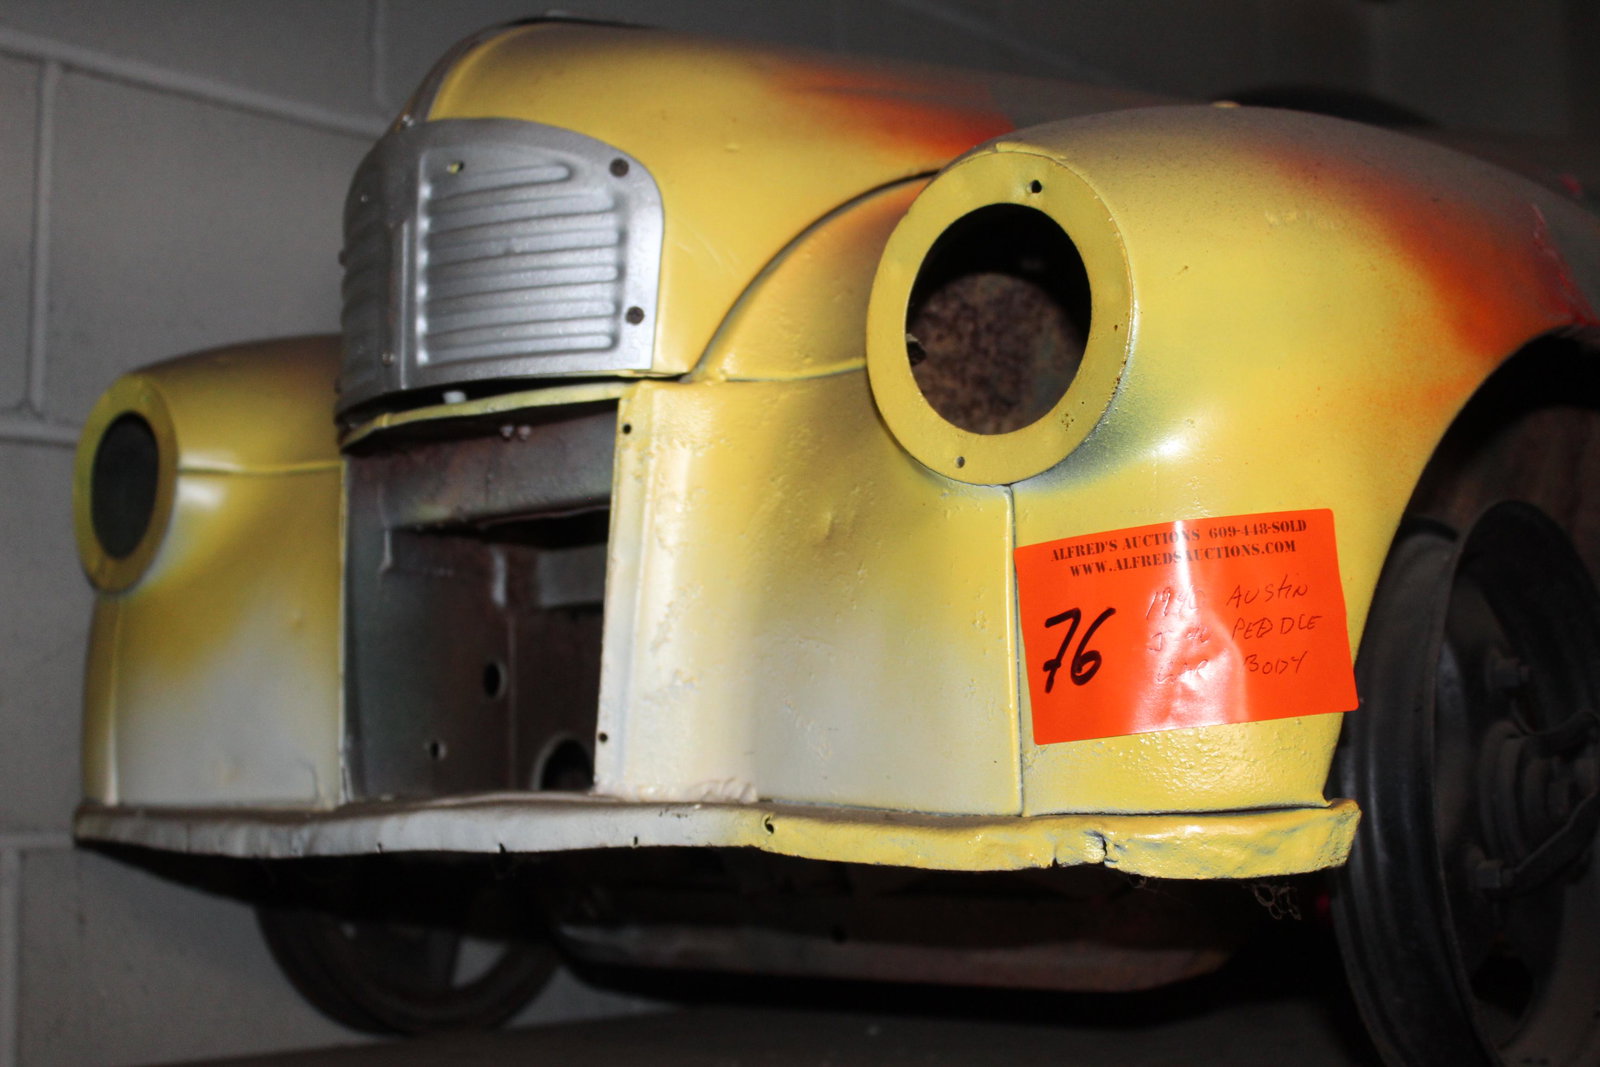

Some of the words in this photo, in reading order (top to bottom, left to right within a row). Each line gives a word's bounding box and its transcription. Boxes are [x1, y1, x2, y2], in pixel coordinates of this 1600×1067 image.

[1050, 539, 1118, 561] ALFRED'S
[1122, 529, 1200, 551] AUCTIONS
[1209, 519, 1307, 539] 609-448-SOLD
[1070, 540, 1296, 577] WWW.ALFREDSAUCTIONS.COM
[1042, 607, 1117, 694] 76
[1243, 651, 1308, 675] BODY
